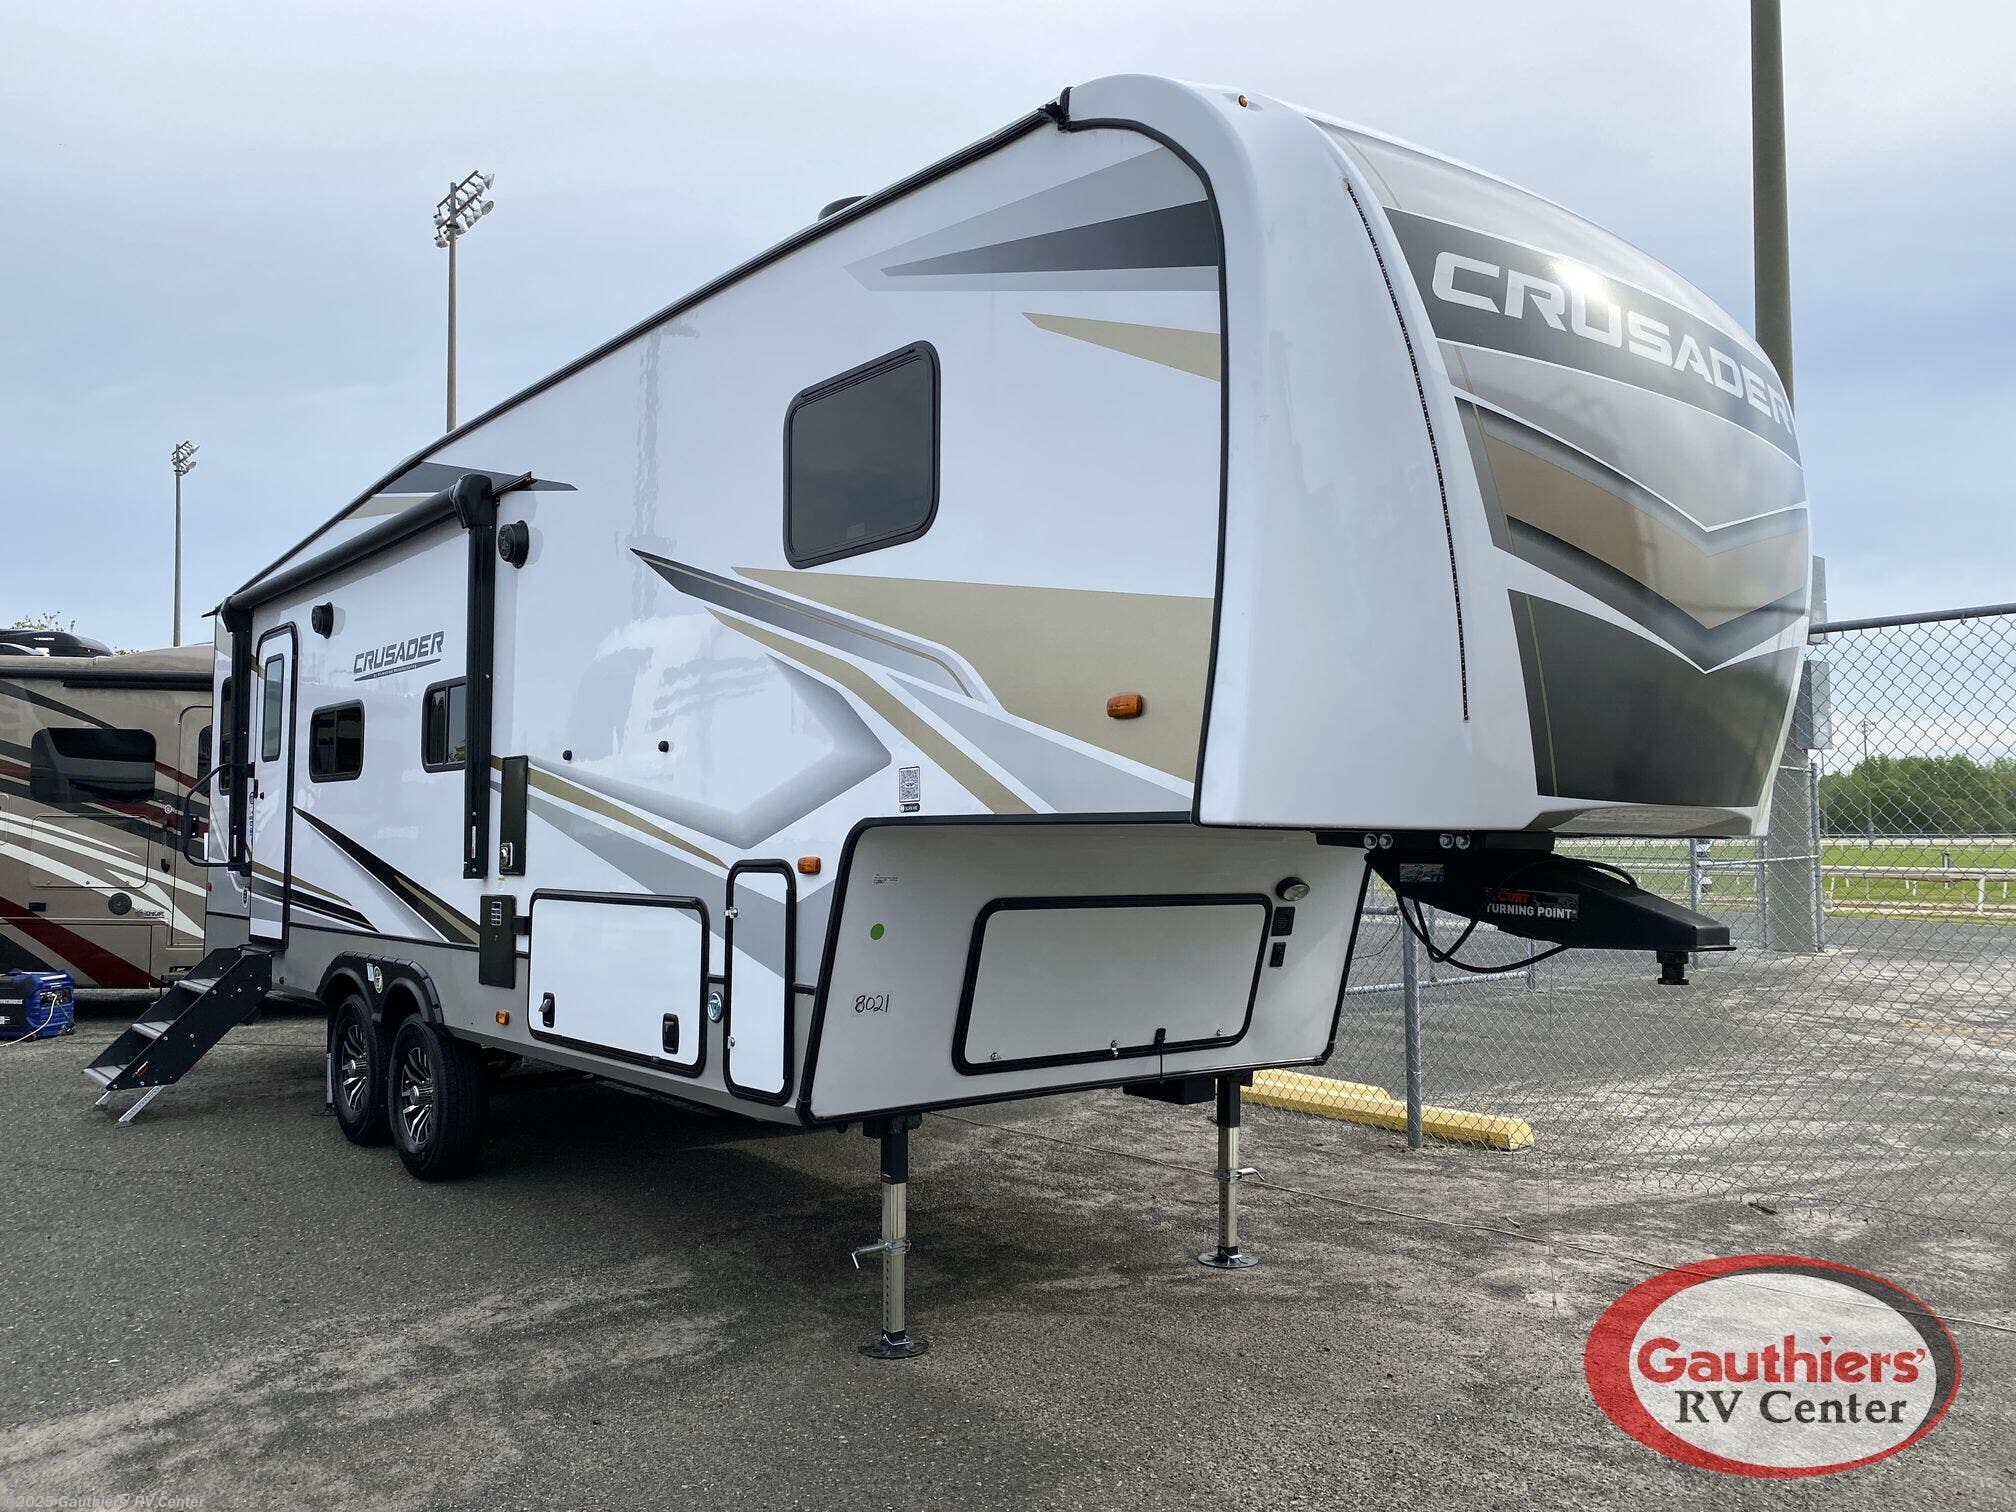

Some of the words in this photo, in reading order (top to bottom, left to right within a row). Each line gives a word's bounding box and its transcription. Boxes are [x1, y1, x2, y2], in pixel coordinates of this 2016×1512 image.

[1432, 251, 1793, 436] CRUSADER
[353, 631, 444, 674] CRUSADER
[1487, 902, 1534, 917] TURNING
[854, 994, 890, 1014] 8021
